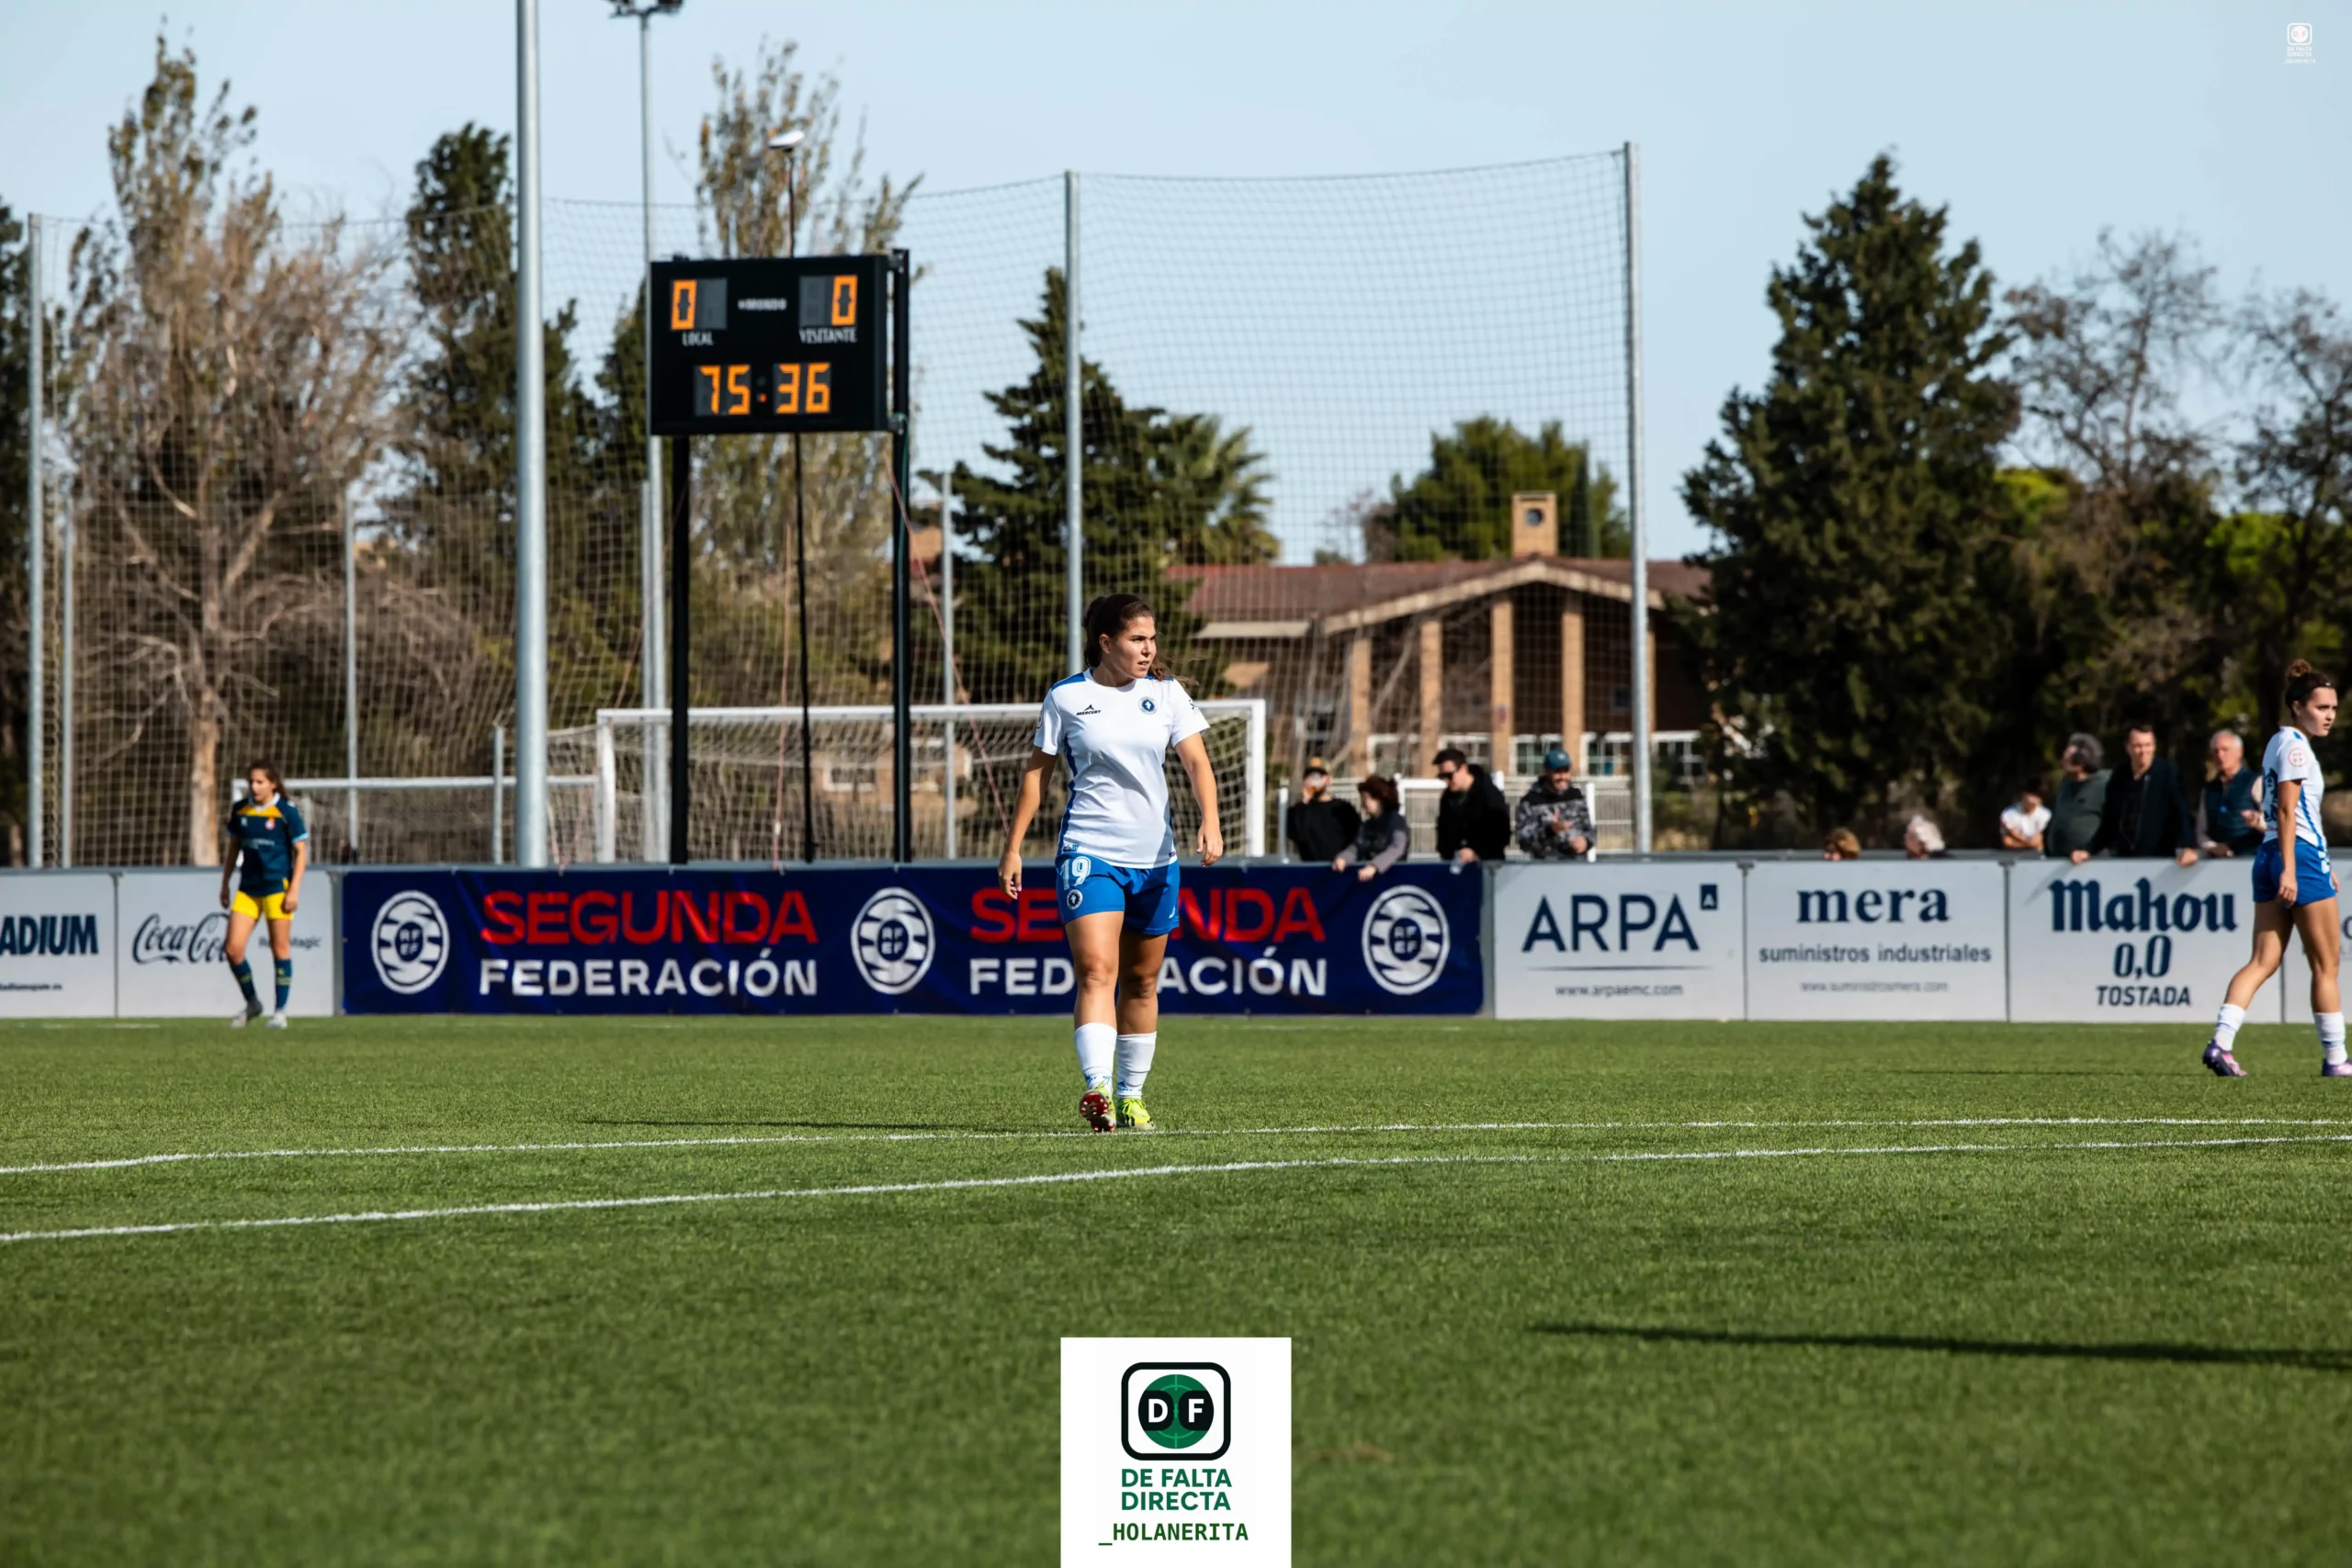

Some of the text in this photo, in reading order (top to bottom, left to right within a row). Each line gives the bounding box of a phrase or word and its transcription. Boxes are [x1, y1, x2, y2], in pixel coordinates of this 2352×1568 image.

[671, 279, 696, 330] 0
[831, 275, 858, 326] 0
[682, 331, 714, 345] LOCAL
[799, 327, 857, 344] VISITANTE
[1059, 855, 1091, 890] 19
[481, 890, 819, 944] SEGUNDA
[970, 887, 1326, 942] SENDA
[1521, 894, 1700, 952] ARPA
[1796, 887, 1950, 924] mera
[2048, 877, 2238, 932] Mahou
[133, 912, 230, 964] Coca-Co
[1758, 942, 1992, 963] suministros industriales
[2113, 934, 2172, 981] 0,0
[479, 949, 818, 996] FEDERACIÓN
[969, 946, 1327, 996] FEDACIÓN
[1555, 984, 1683, 997] www.arpaemc.com
[2097, 986, 2191, 1006] TOSTADA
